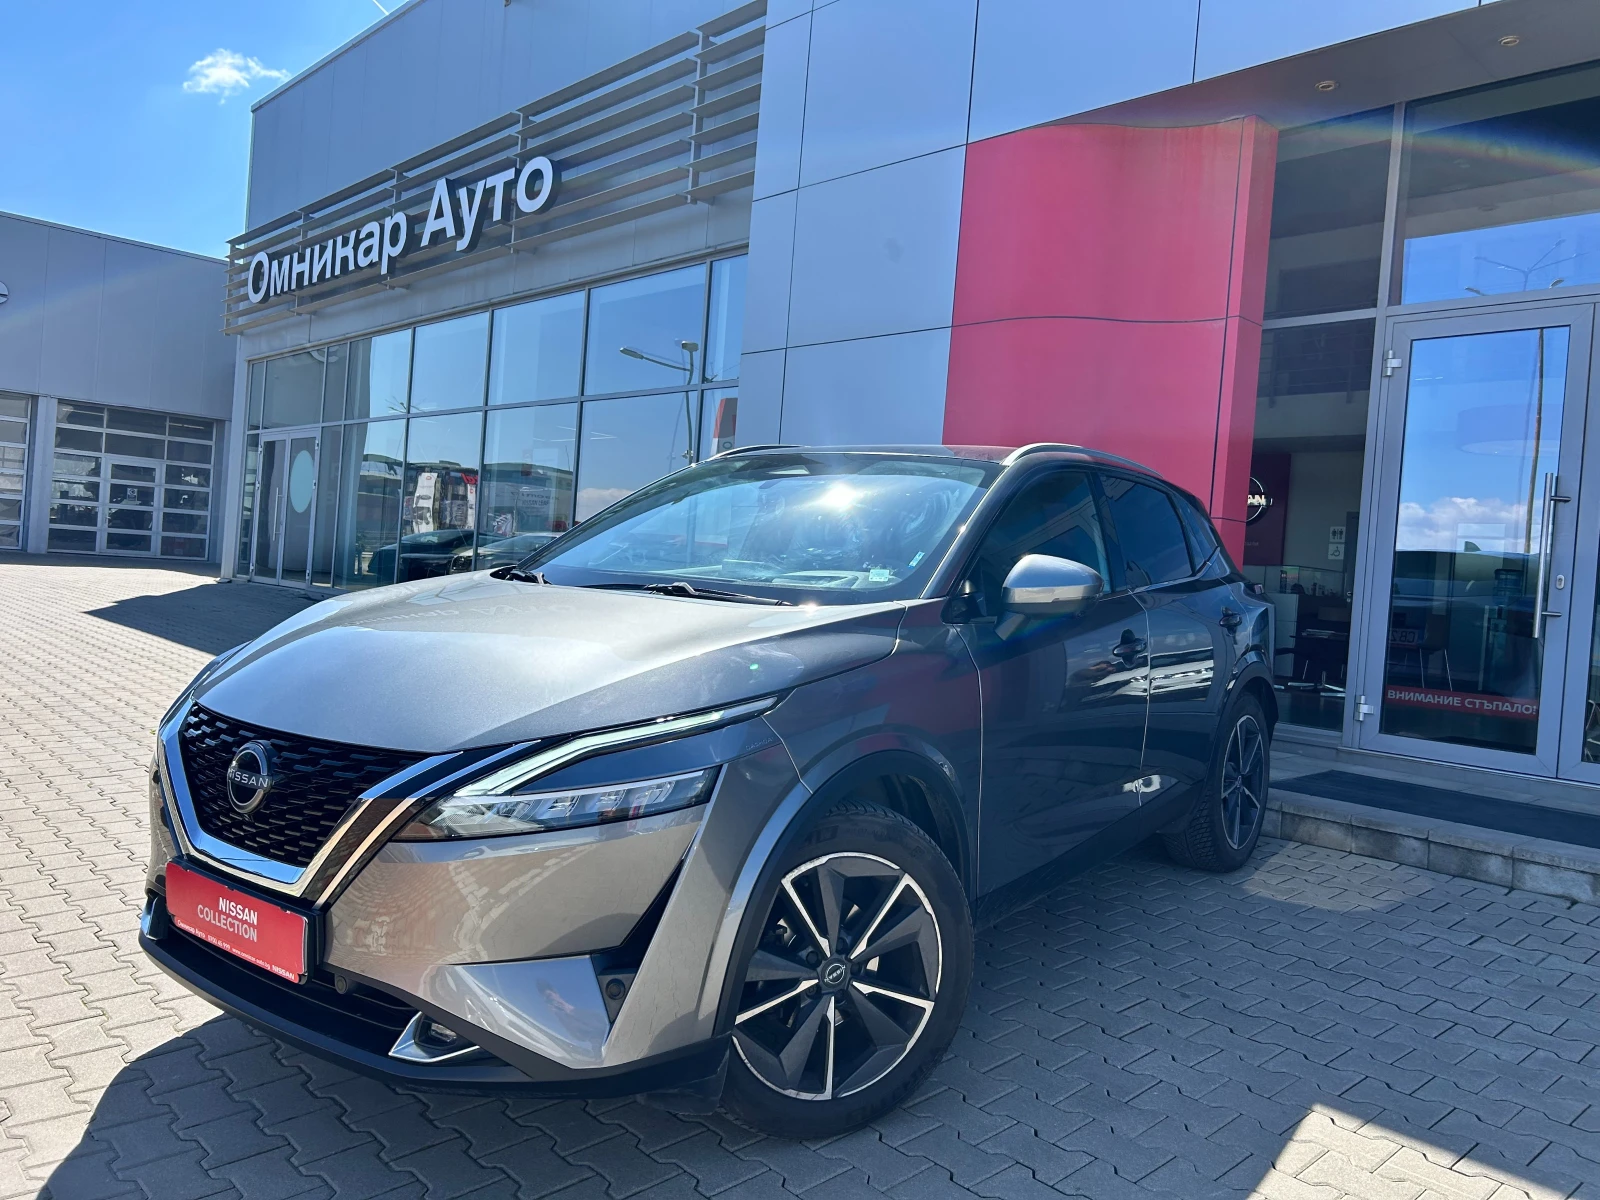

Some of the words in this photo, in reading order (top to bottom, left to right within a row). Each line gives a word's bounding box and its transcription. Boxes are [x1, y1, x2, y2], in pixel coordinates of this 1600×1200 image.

[247, 211, 408, 304] Омникар
[420, 156, 554, 252] Ауто
[1387, 689, 1462, 706] ВНИМАНИЕ
[1464, 698, 1538, 715] СТЪПАЛО!
[228, 768, 269, 788] NISSAN
[197, 904, 257, 942] COLLECTION
[218, 897, 258, 925] NISSAN
[272, 964, 295, 980] NISSAN
